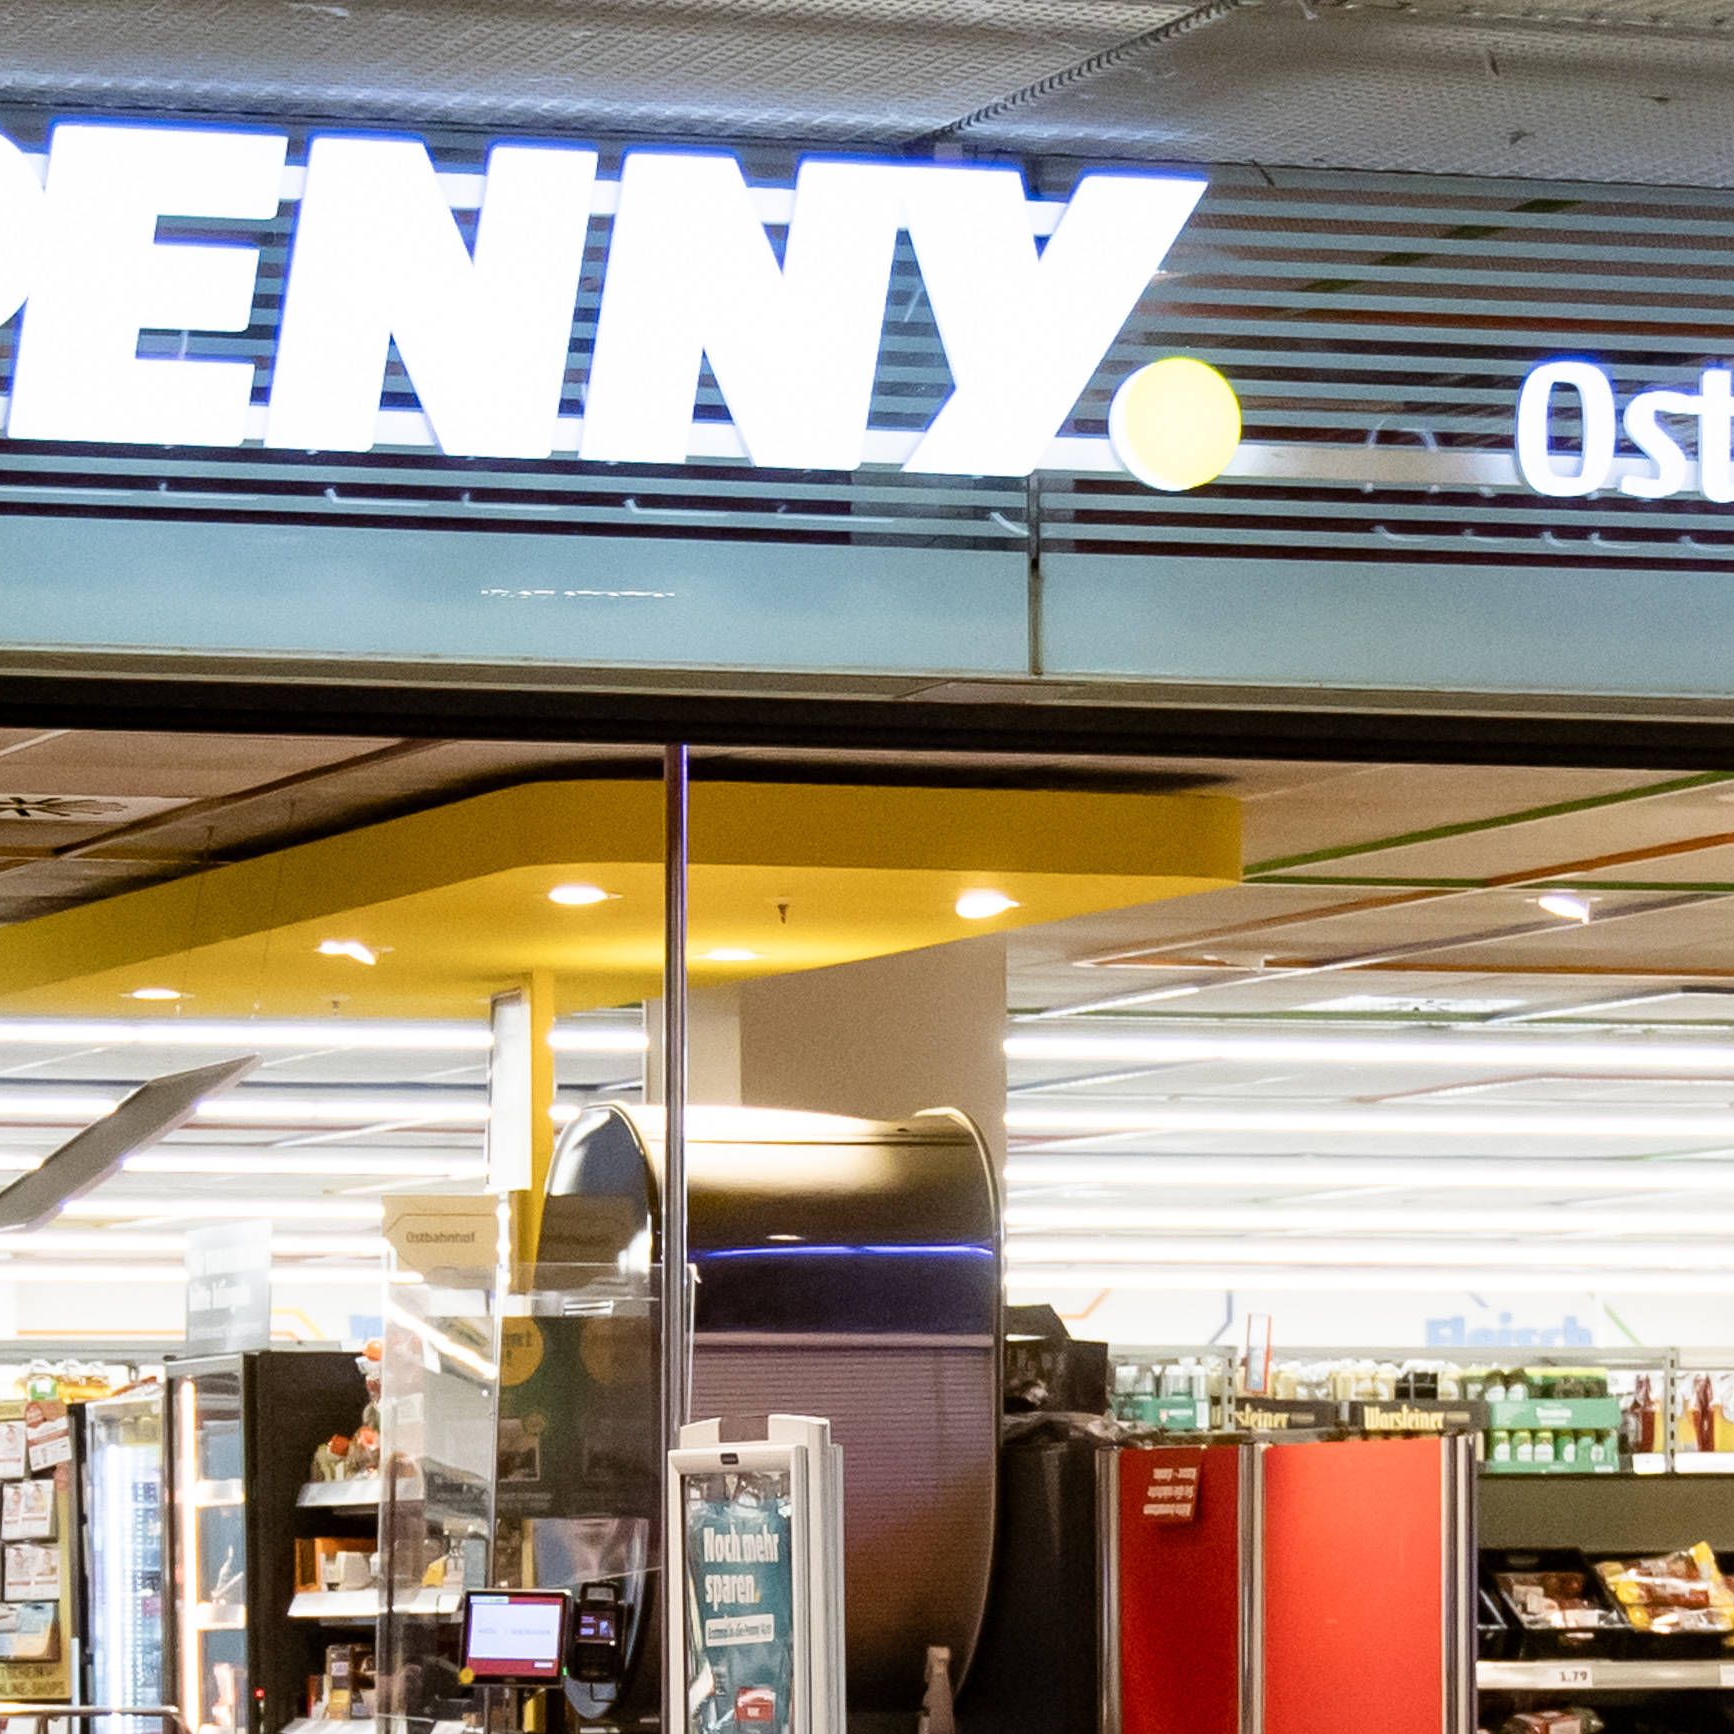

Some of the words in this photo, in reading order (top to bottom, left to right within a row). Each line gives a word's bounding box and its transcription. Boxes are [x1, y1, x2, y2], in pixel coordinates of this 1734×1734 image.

[1233, 1406, 1290, 1430] steiner
[1363, 1404, 1445, 1431] Warsteiner
[704, 1526, 740, 1563] Noch
[742, 1525, 779, 1562] mehr
[704, 1572, 761, 1612] sparen.
